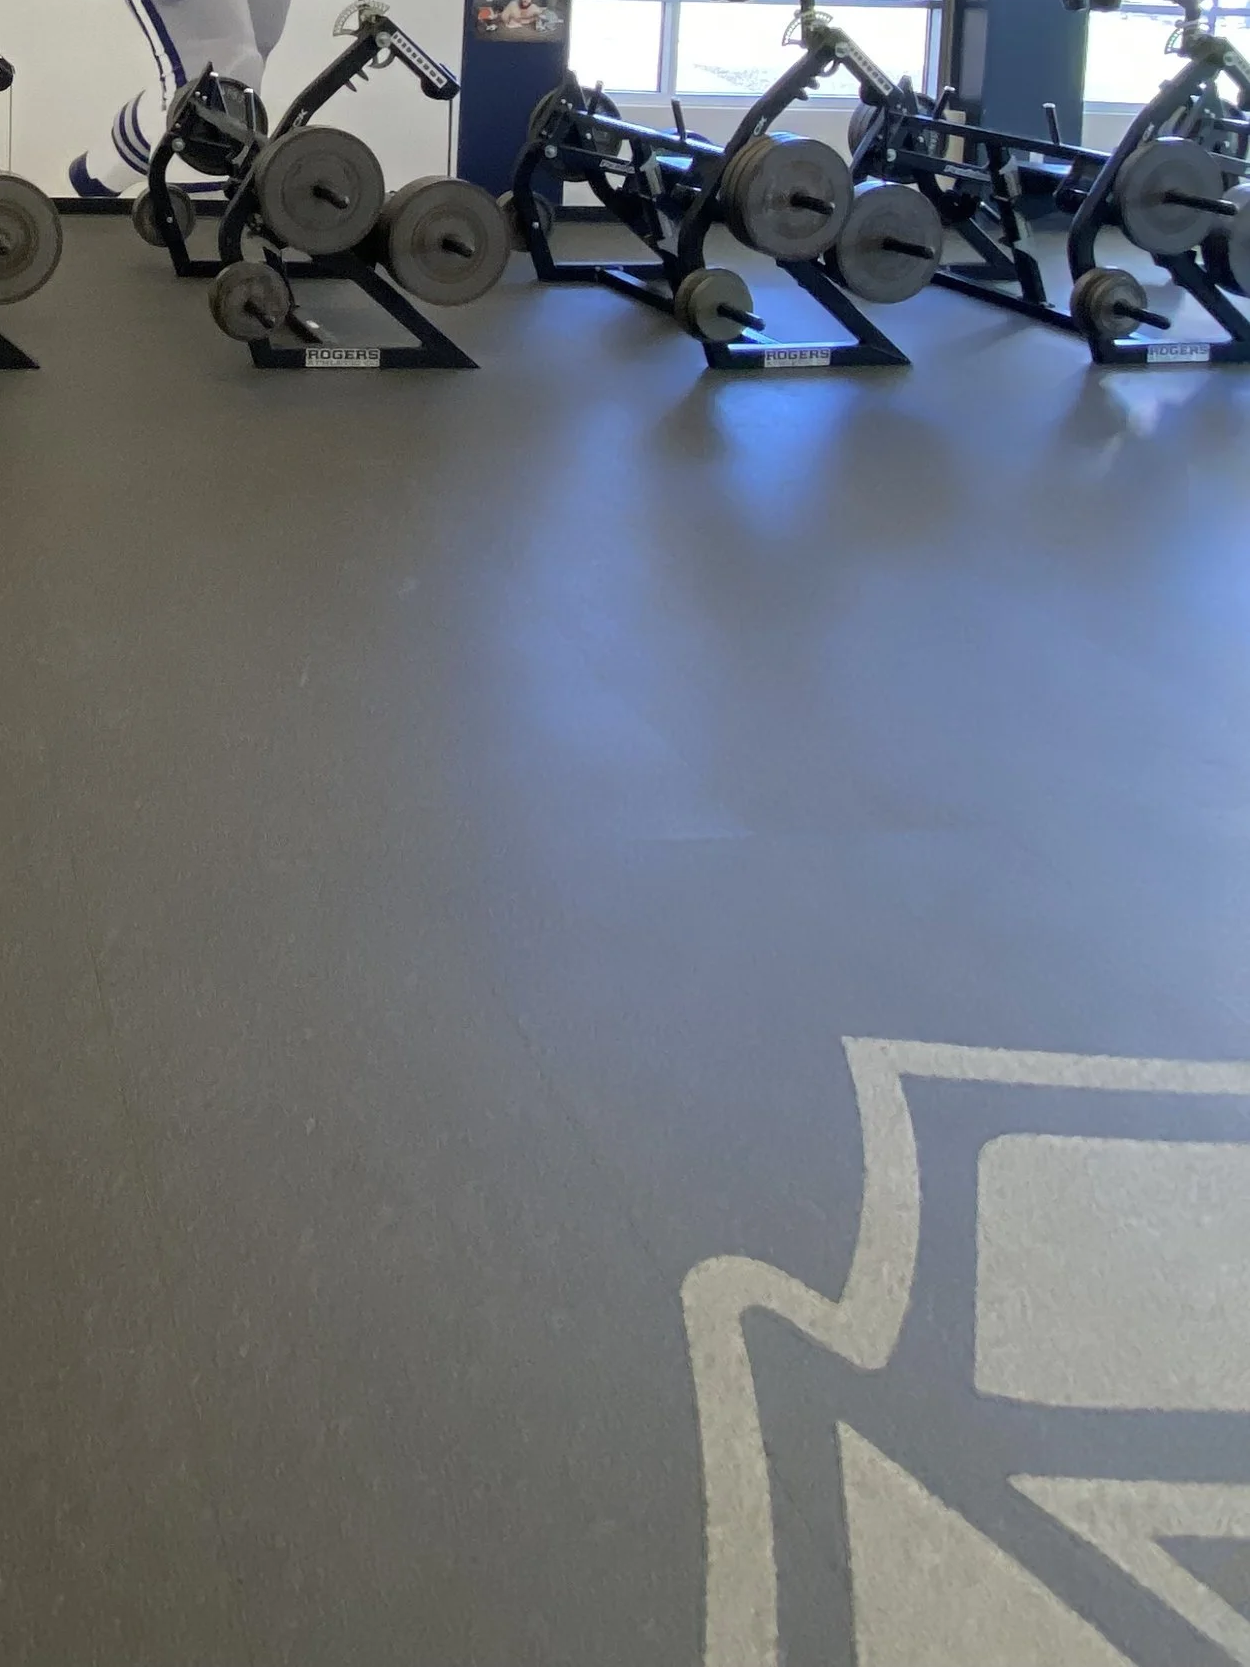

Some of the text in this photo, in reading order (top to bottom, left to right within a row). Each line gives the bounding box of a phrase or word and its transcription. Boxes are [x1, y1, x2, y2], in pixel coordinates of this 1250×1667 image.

[308, 350, 379, 360] ROGERS
[766, 349, 829, 361] ROGERS
[1150, 345, 1208, 356] ROGERS
